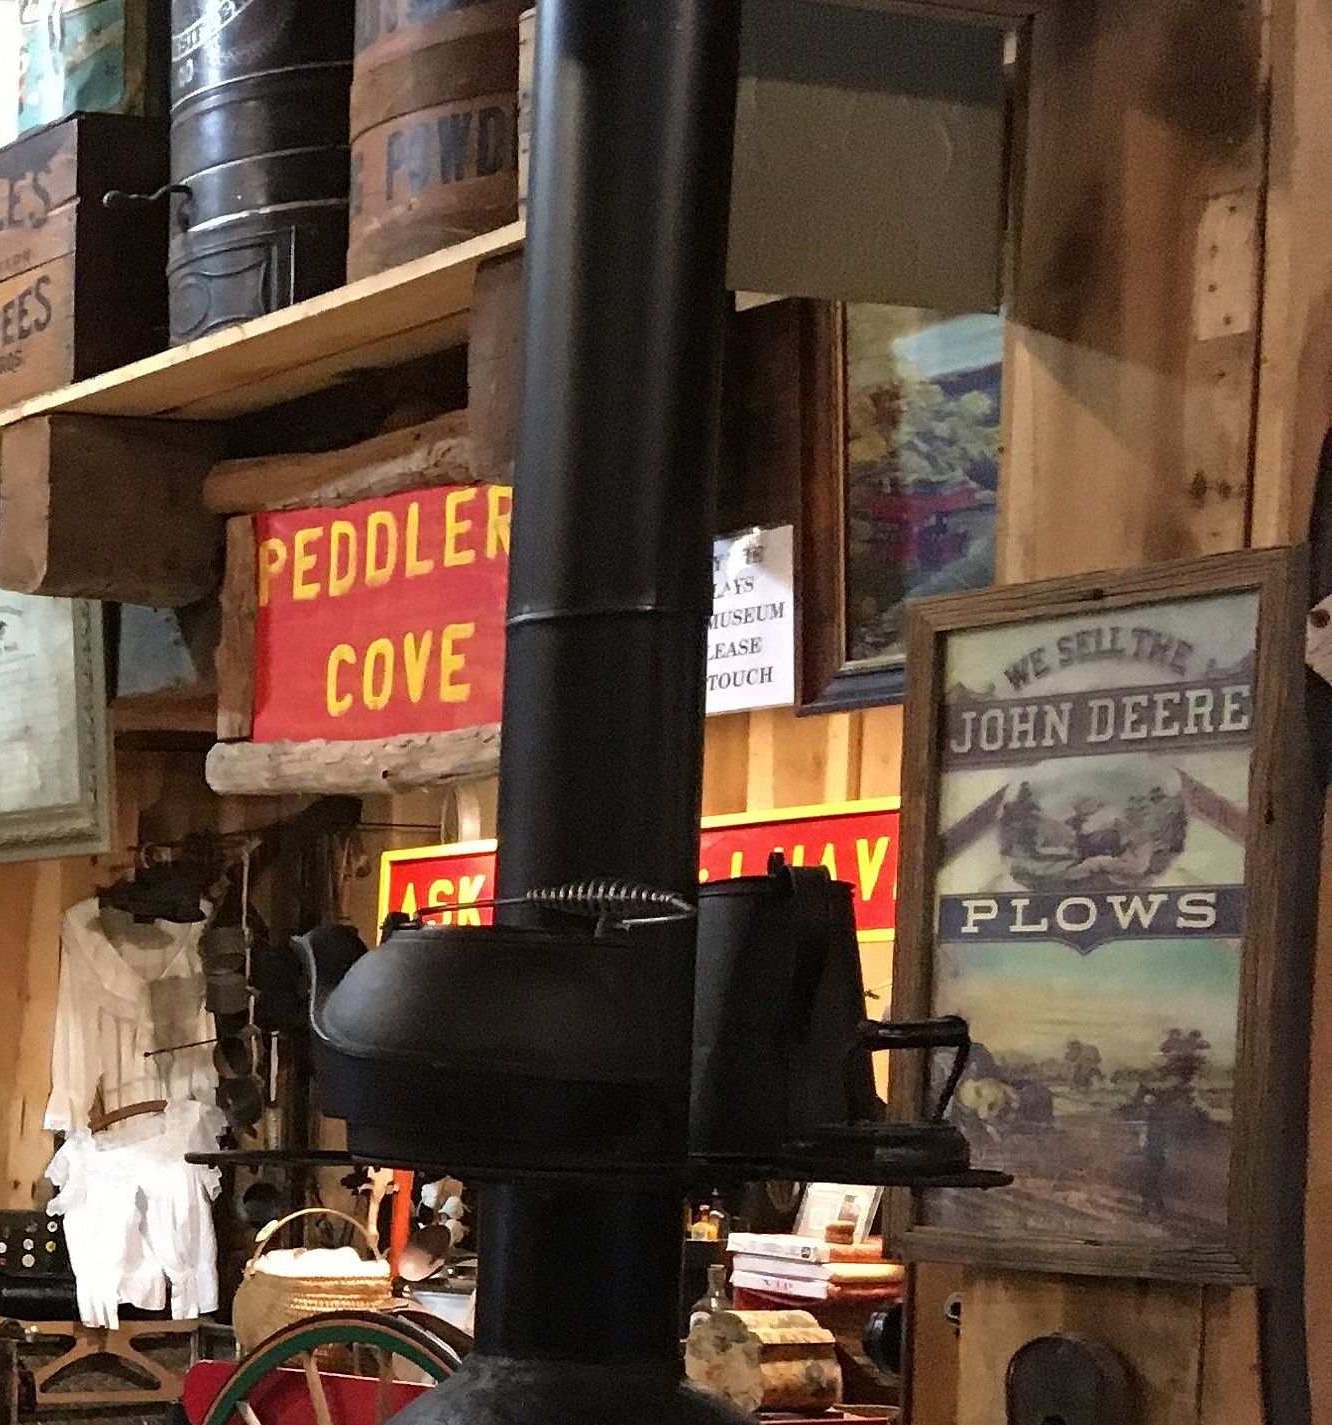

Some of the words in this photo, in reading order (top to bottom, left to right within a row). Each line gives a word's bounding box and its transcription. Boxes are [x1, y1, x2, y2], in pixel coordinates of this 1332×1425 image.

[325, 621, 476, 717] COVE
[706, 665, 775, 692] TOUCH
[1004, 647, 1048, 692] WE
[1056, 625, 1127, 667] SELL
[1131, 626, 1195, 677] THE
[949, 699, 1075, 755] JOHN
[1085, 683, 1254, 745] DEERE
[399, 872, 488, 926] ASK
[960, 891, 1221, 935] PLOWS
